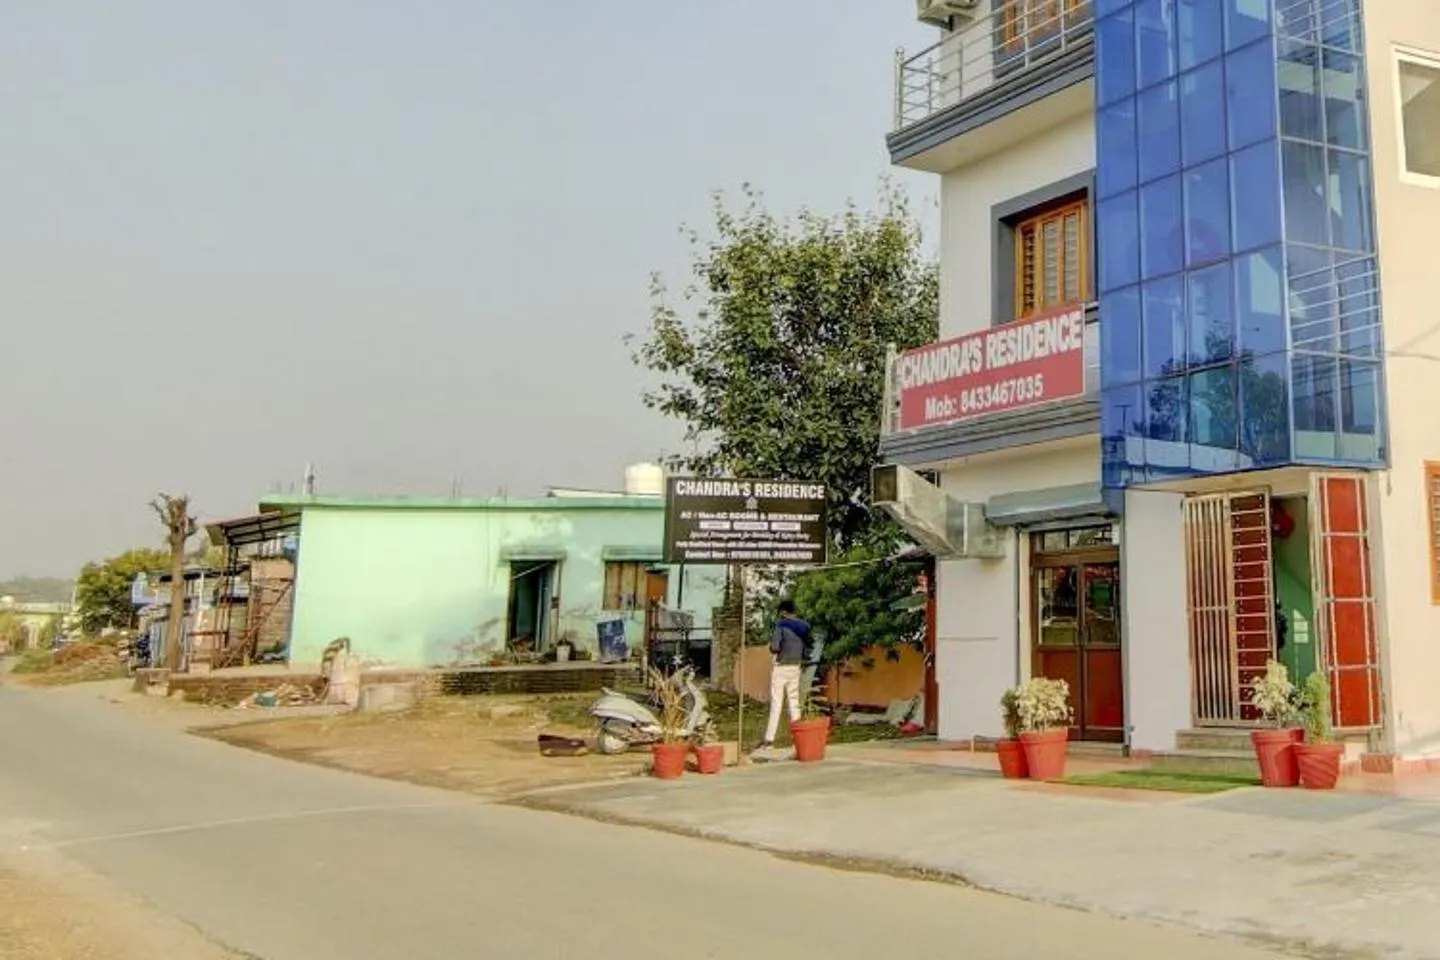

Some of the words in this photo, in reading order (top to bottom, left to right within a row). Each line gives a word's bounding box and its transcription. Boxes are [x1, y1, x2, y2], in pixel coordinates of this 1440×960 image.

[902, 337, 983, 388] CHANDRA'S
[986, 310, 1082, 369] RESIDENCE
[925, 397, 957, 420] Mob:
[961, 373, 1044, 413] 8433467035
[676, 481, 752, 497] CHANDRA'S
[755, 483, 825, 499] RESIDENCE
